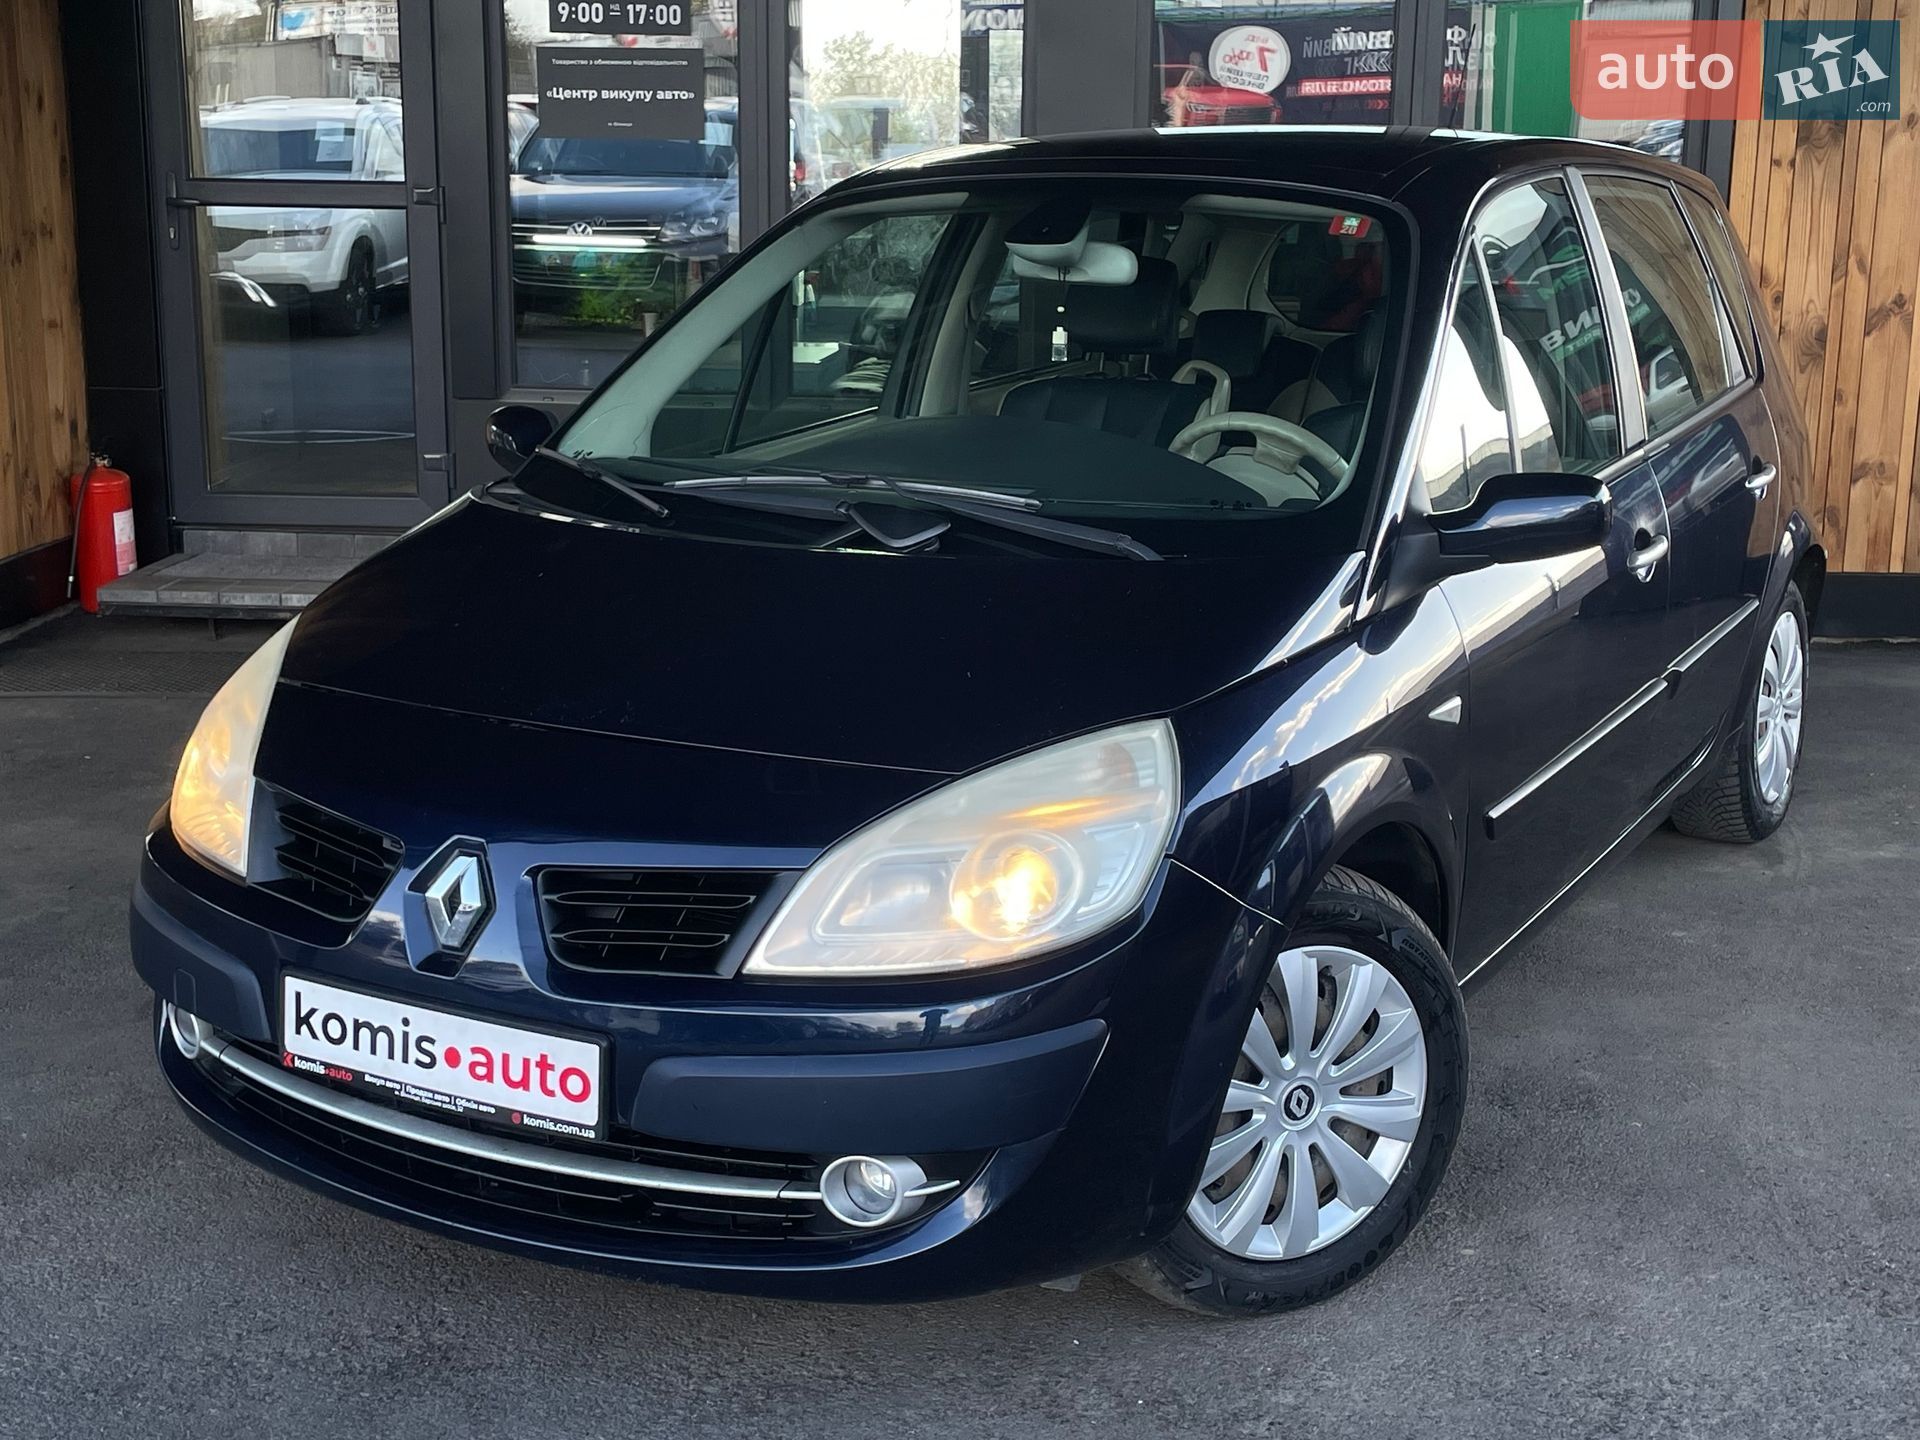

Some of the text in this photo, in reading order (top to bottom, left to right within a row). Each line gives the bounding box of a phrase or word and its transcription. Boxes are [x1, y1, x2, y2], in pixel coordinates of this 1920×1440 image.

[557, 2, 604, 23] 9:00
[626, 4, 682, 25] 17:00
[546, 87, 695, 102] «Центр викупу авто»
[523, 1113, 596, 1140] komis.com.ua
